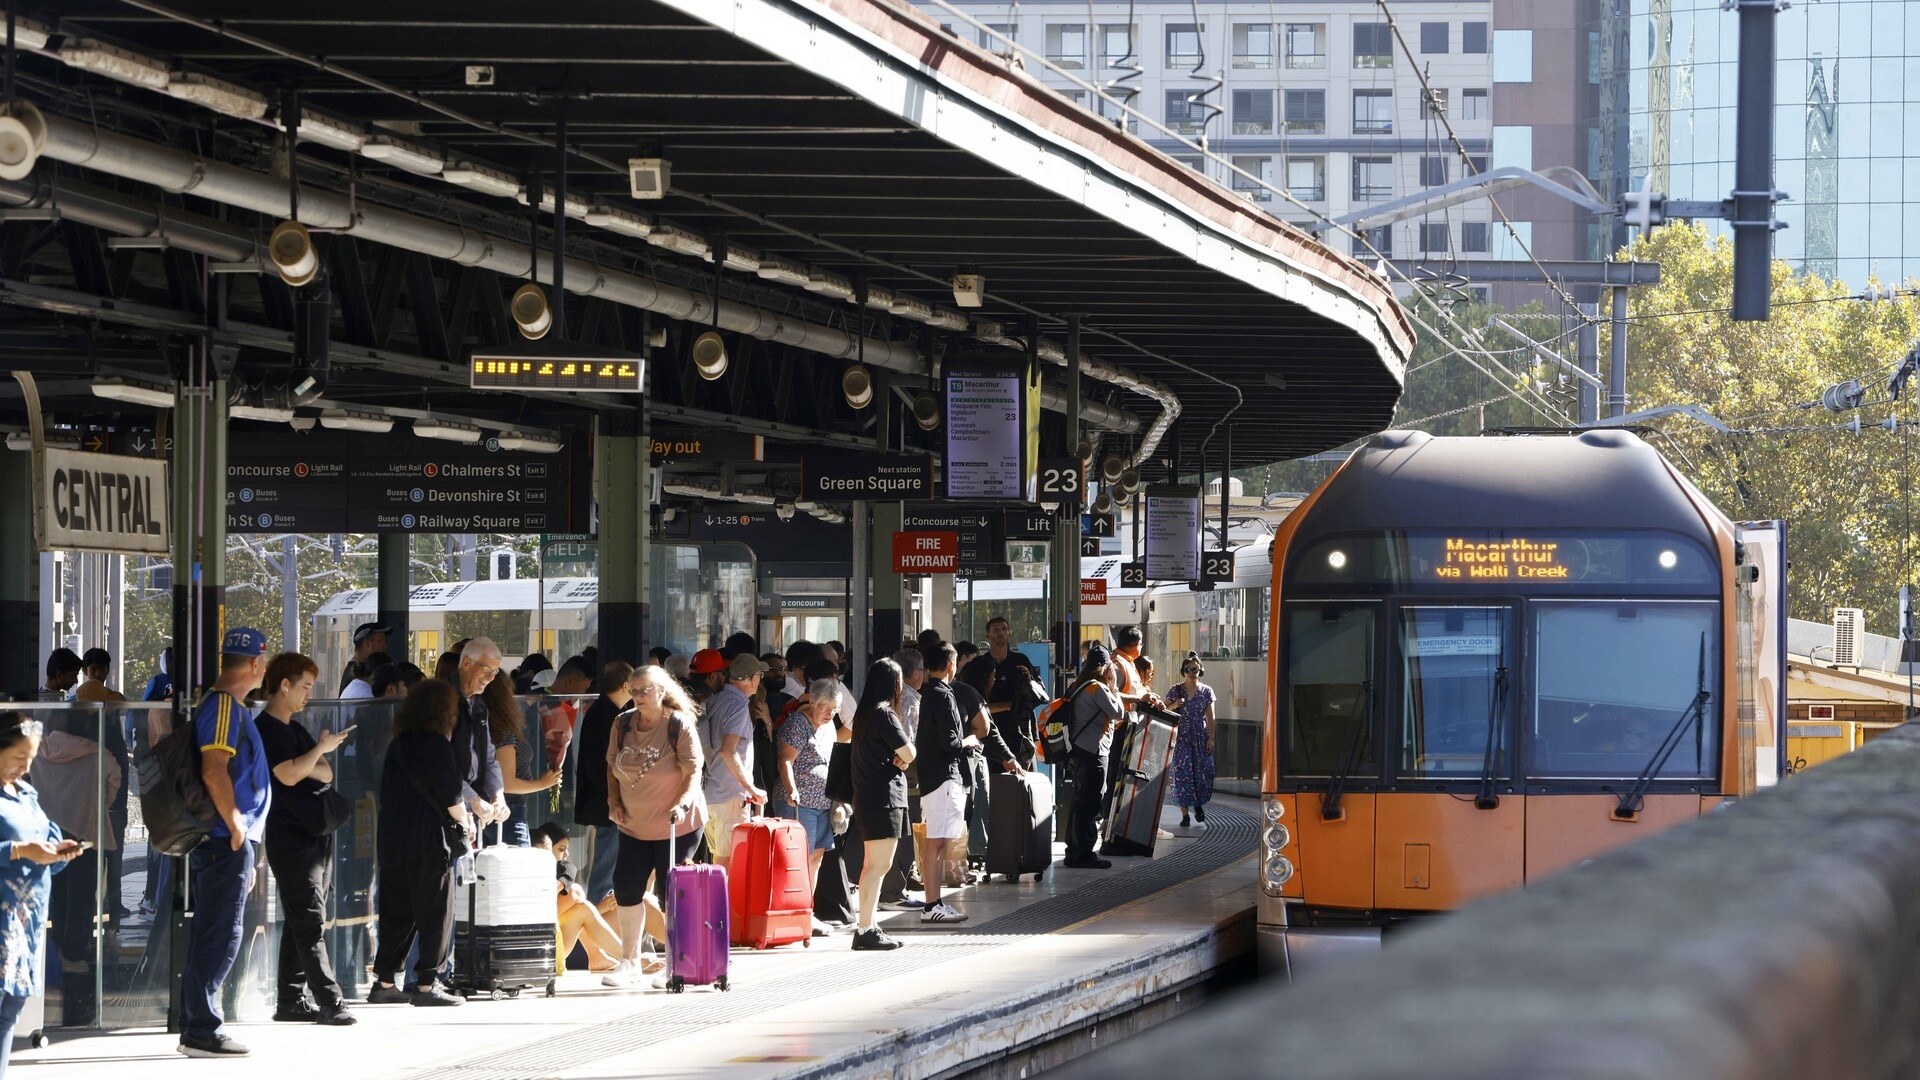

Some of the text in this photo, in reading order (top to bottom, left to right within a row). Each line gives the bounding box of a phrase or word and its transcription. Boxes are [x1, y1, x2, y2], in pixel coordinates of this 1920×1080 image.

[676, 440, 701, 454] out
[442, 464, 504, 476] Chalmers
[507, 464, 521, 476] St
[820, 476, 922, 492] Green Square
[1044, 469, 1078, 492] 23
[53, 468, 161, 536] CENTRAL
[429, 490, 504, 502] Devonshire
[507, 490, 521, 502] St
[240, 515, 253, 527] St
[420, 516, 470, 530] Railway
[473, 516, 520, 530] Square
[717, 516, 738, 525] 1-25
[912, 518, 959, 526] Concourse
[1027, 518, 1050, 531] Lift
[547, 544, 586, 556] HELP
[916, 538, 940, 550] FIRE
[1446, 539, 1557, 562] Macarthur
[902, 555, 955, 567] HYDRANT
[1206, 559, 1231, 576] 23
[1124, 569, 1144, 583] 23
[1436, 565, 1567, 578] via Wolli Creek
